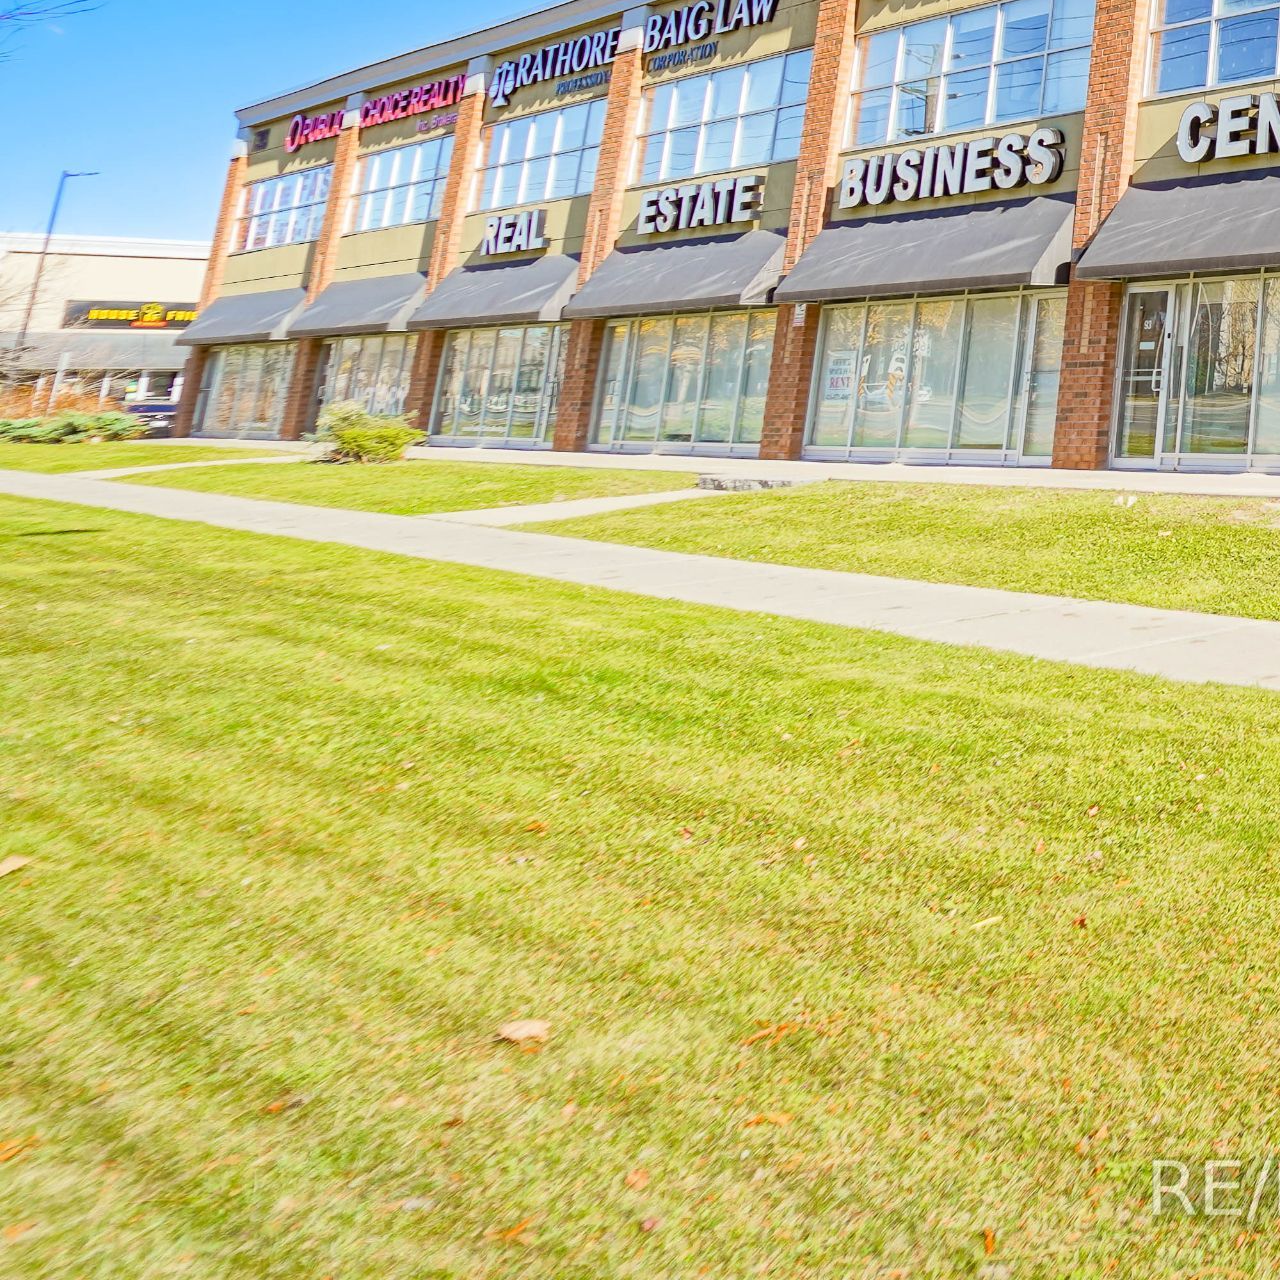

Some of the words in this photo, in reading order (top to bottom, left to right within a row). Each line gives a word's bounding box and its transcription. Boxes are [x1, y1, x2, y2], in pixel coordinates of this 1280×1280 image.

[515, 27, 621, 88] RATHORE
[643, 0, 713, 53] BAIG
[646, 40, 719, 73] CORPORATION
[839, 128, 1064, 209] BUSINESS
[637, 176, 762, 235] ESTATE
[480, 209, 548, 256] REAL
[1143, 320, 1153, 330] 93
